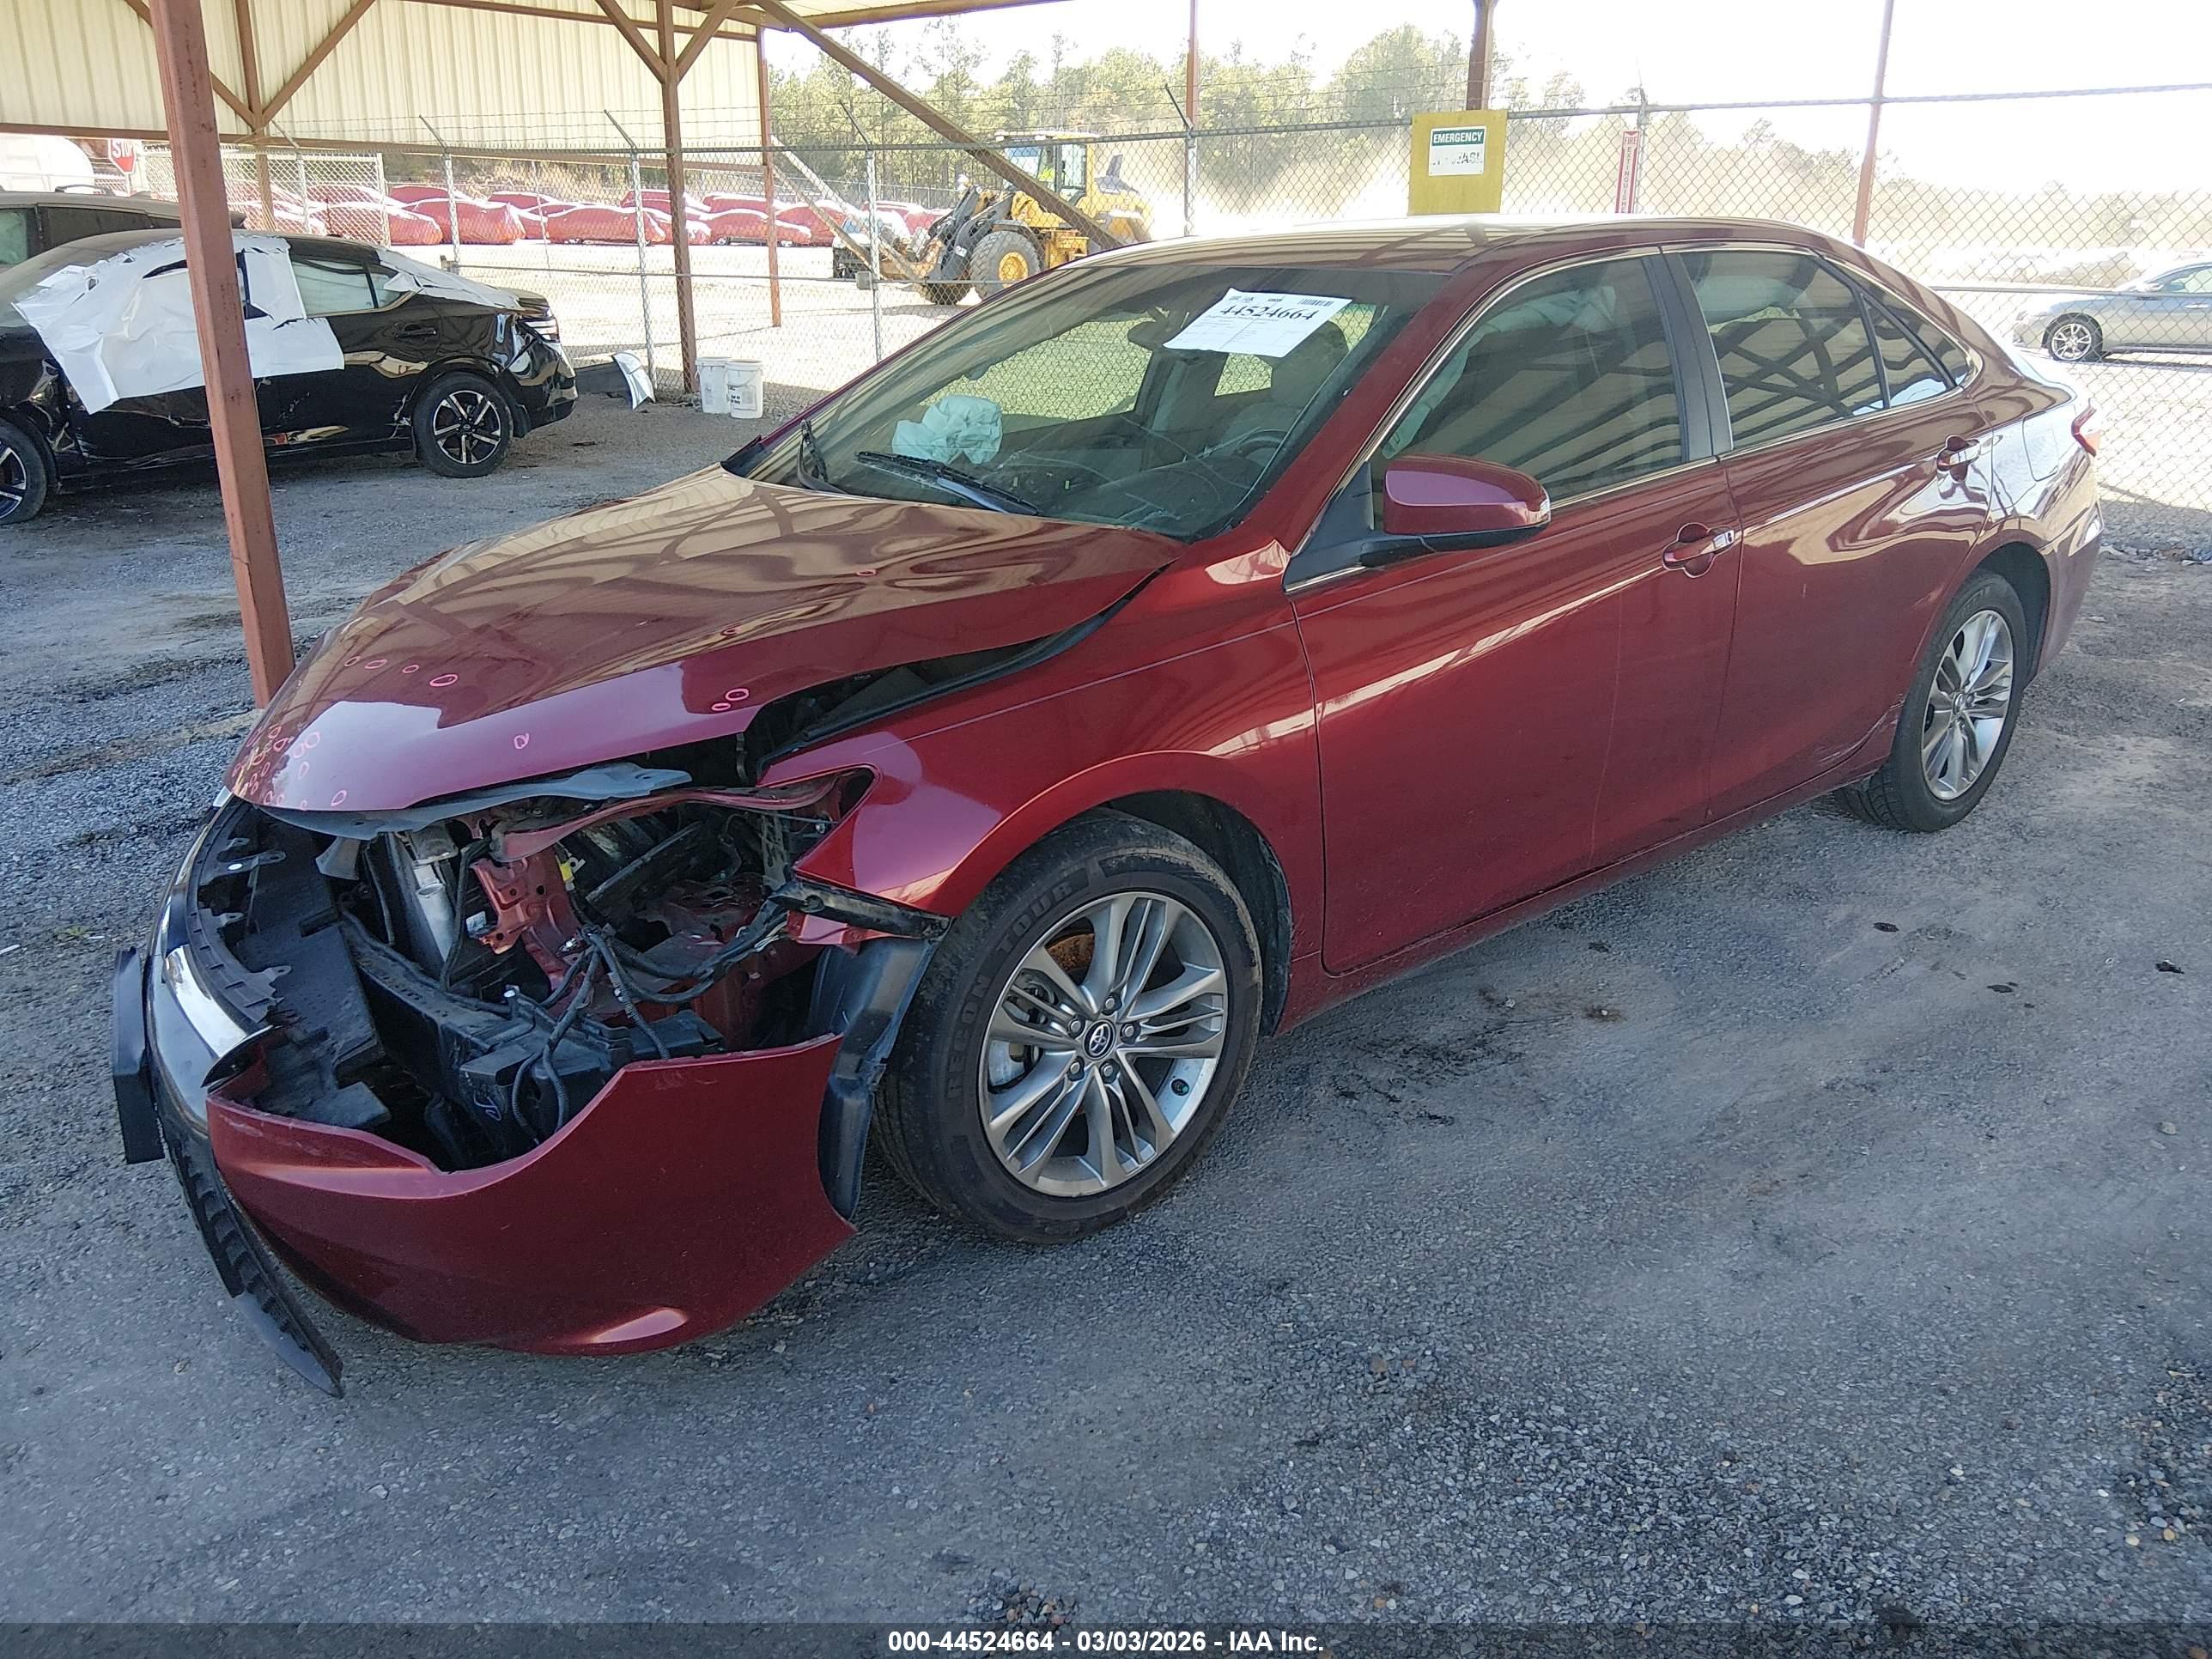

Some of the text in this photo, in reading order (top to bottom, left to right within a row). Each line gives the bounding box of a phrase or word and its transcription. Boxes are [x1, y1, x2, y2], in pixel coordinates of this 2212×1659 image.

[1432, 131, 1483, 143] EMERGENCY
[1620, 146, 1632, 213] EXTINGUISHE
[1220, 304, 1318, 320] 44524664
[996, 878, 1073, 952] TOUR
